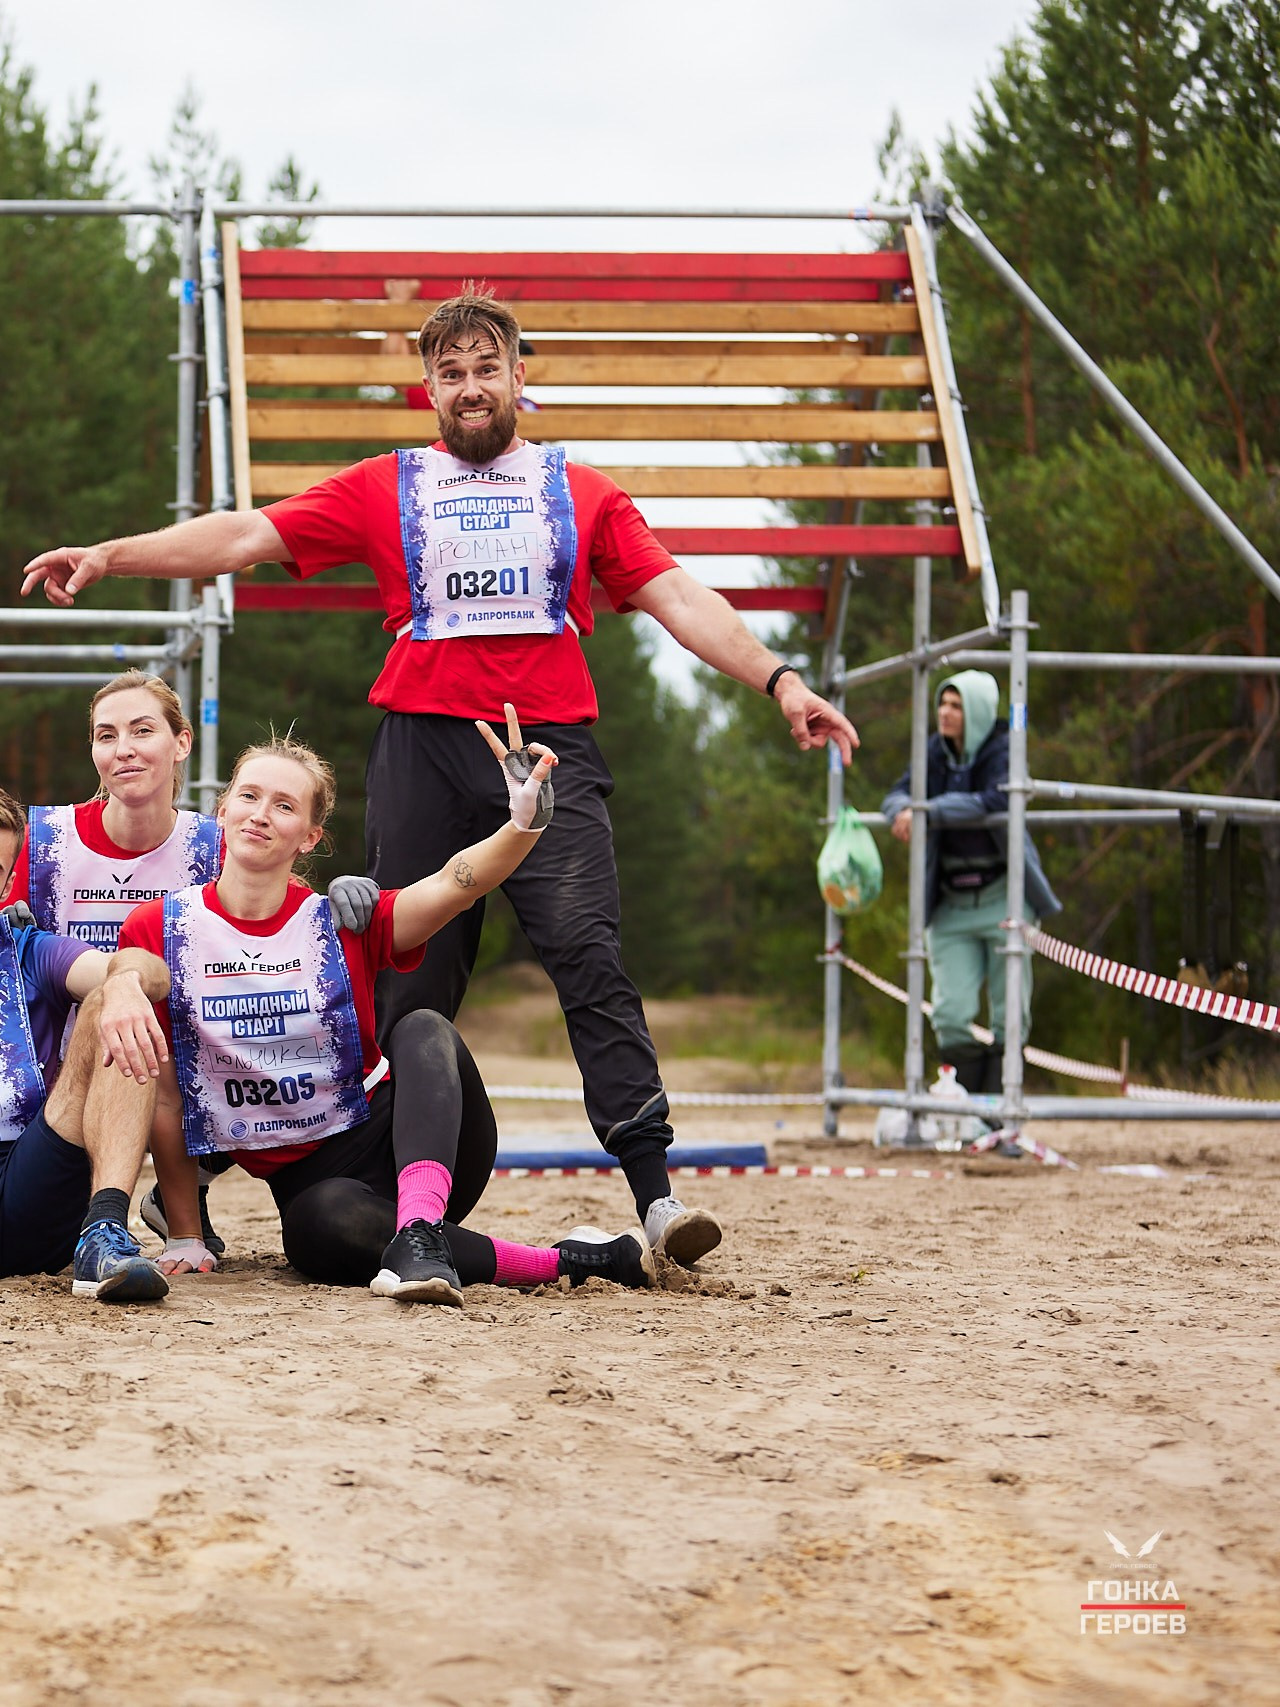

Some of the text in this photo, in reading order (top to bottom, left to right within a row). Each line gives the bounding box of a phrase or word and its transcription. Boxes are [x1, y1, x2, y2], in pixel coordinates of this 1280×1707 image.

[438, 471, 527, 487] ГОНКА ГЕРОЕВ
[435, 497, 532, 517] КОМАНДНЫЙ
[462, 514, 508, 530] СТАРТ
[438, 536, 528, 564] РОМАН
[446, 566, 529, 600] 03201
[467, 610, 535, 622] ГАЗПРОМБАНК
[73, 889, 116, 900] ГОНКА
[205, 958, 301, 974] ГОНКА ГЕРОЕВ
[204, 989, 308, 1018] КОМАНДНЫЙ
[234, 1018, 282, 1036] СТАРТ
[224, 1072, 316, 1108] 03205
[254, 1112, 327, 1133] ГАЗПРОМБАНК
